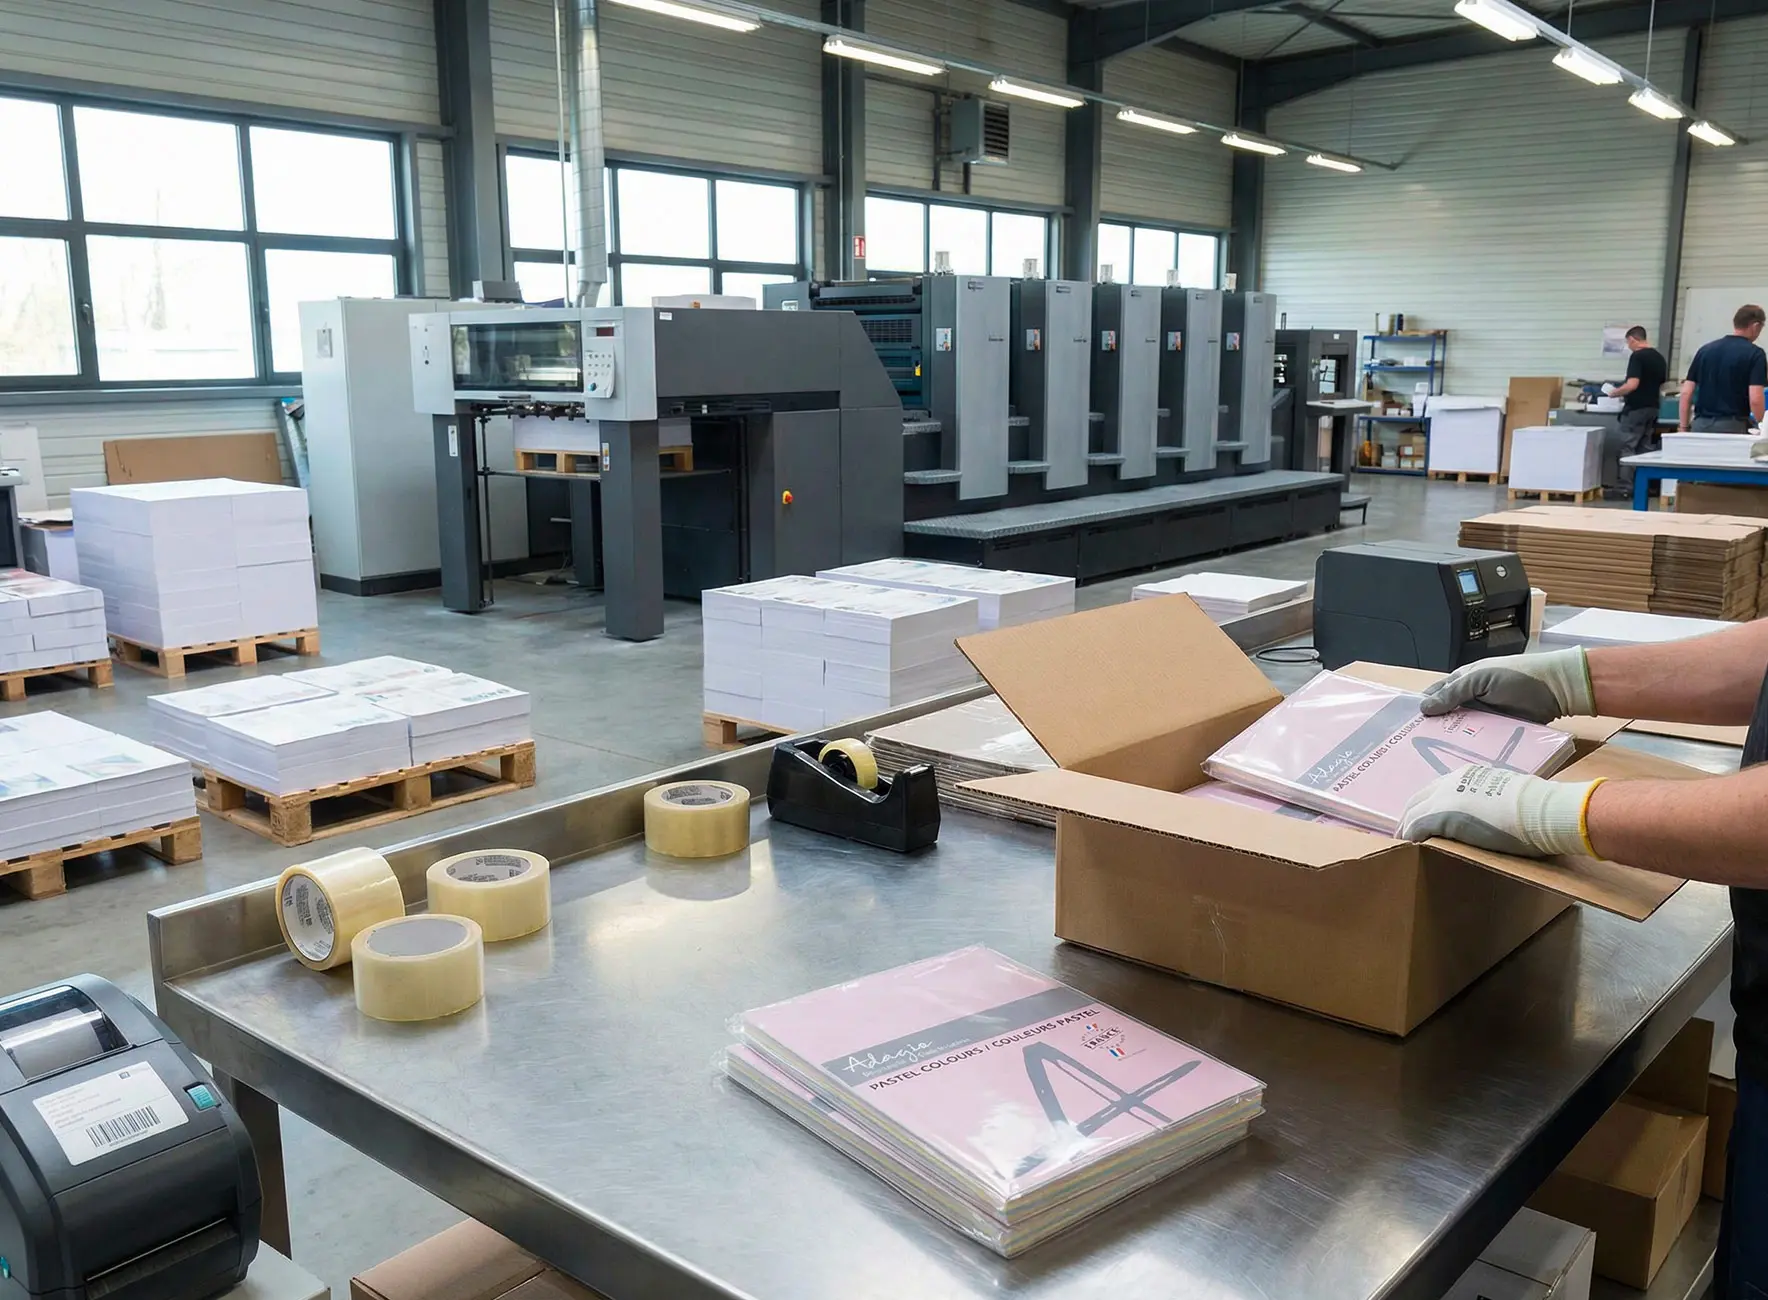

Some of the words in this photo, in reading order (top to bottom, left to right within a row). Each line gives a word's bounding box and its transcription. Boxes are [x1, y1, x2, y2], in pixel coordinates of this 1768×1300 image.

[842, 1041, 933, 1073] Adagio
[869, 1070, 921, 1091] PASTEL
[920, 1047, 984, 1073] COLOURS
[991, 1022, 1057, 1048] COULEURS
[1056, 1008, 1101, 1027] PASTEL
